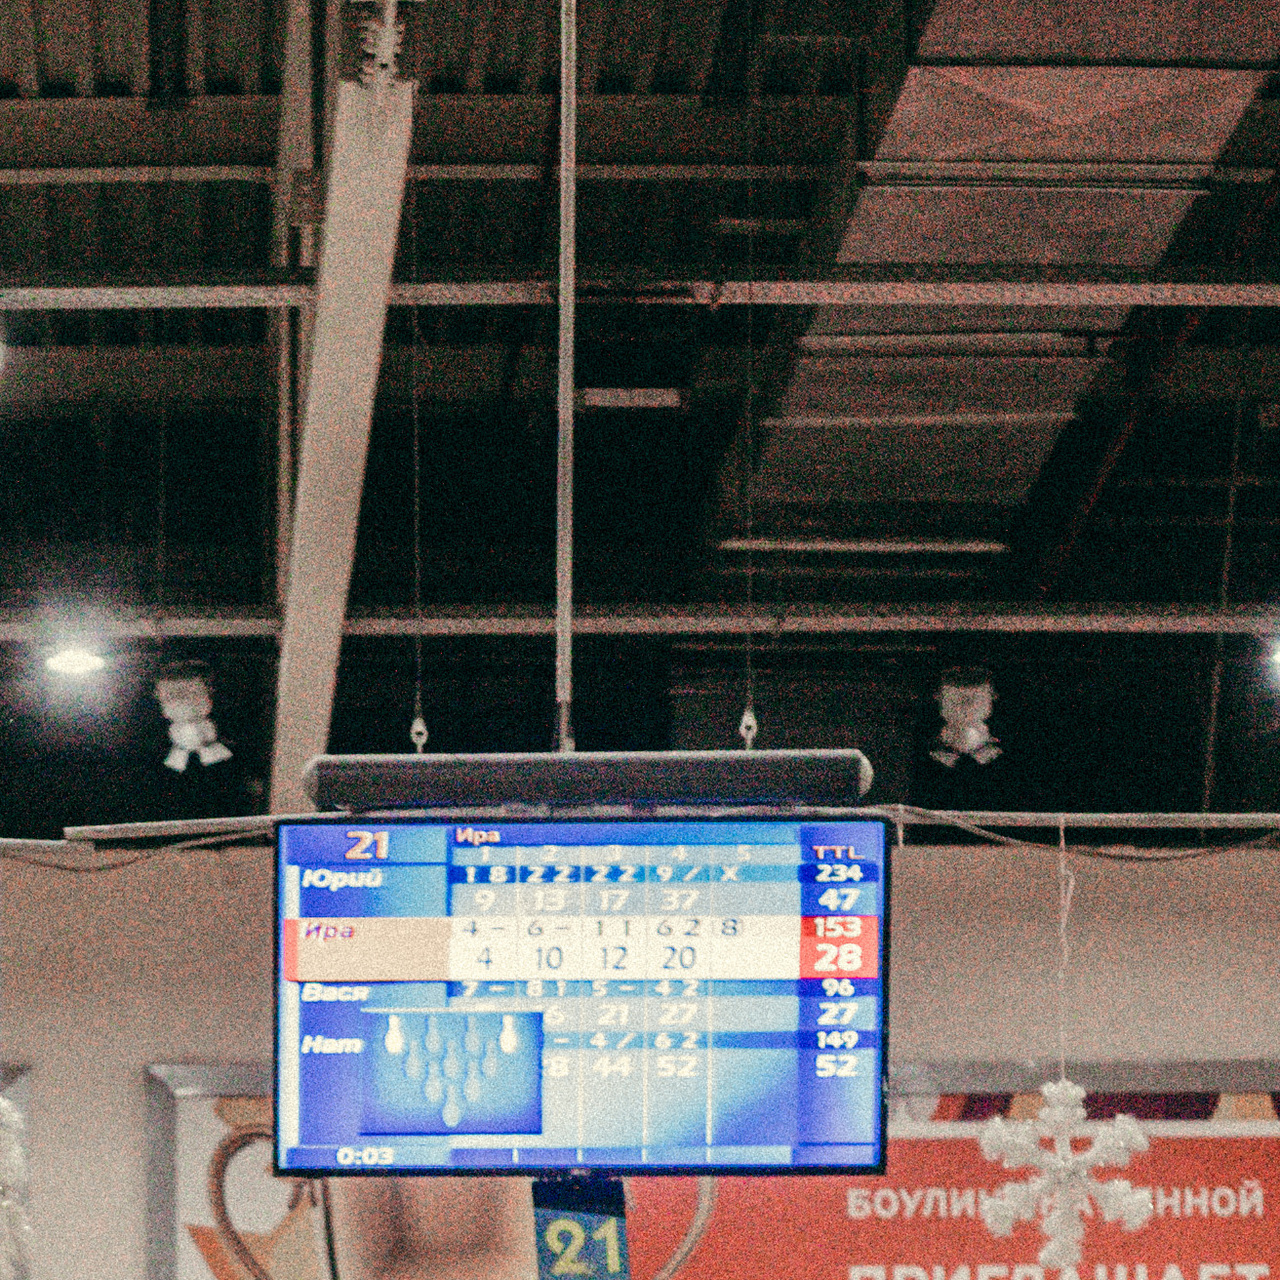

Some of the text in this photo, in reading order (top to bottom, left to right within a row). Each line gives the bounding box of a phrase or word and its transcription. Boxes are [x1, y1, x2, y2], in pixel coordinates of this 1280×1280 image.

[344, 830, 389, 861] 21
[455, 828, 501, 846] Ира
[813, 845, 865, 861] TTL
[302, 868, 383, 892] Юрий
[815, 864, 864, 882] 234
[474, 888, 861, 912] 9 13 17 37 47
[304, 917, 863, 942] Ира 153
[476, 943, 863, 972] 4 10 12 20 28
[301, 983, 370, 1002] Вася
[821, 978, 855, 998] 96
[545, 1002, 860, 1027] 6 21 27 27
[816, 1030, 860, 1049] 149
[545, 1054, 859, 1078] 8 44 52 52
[336, 1147, 395, 1166] 0:03
[1154, 1179, 1265, 1218] ННОЙ
[545, 1216, 621, 1276] 21
